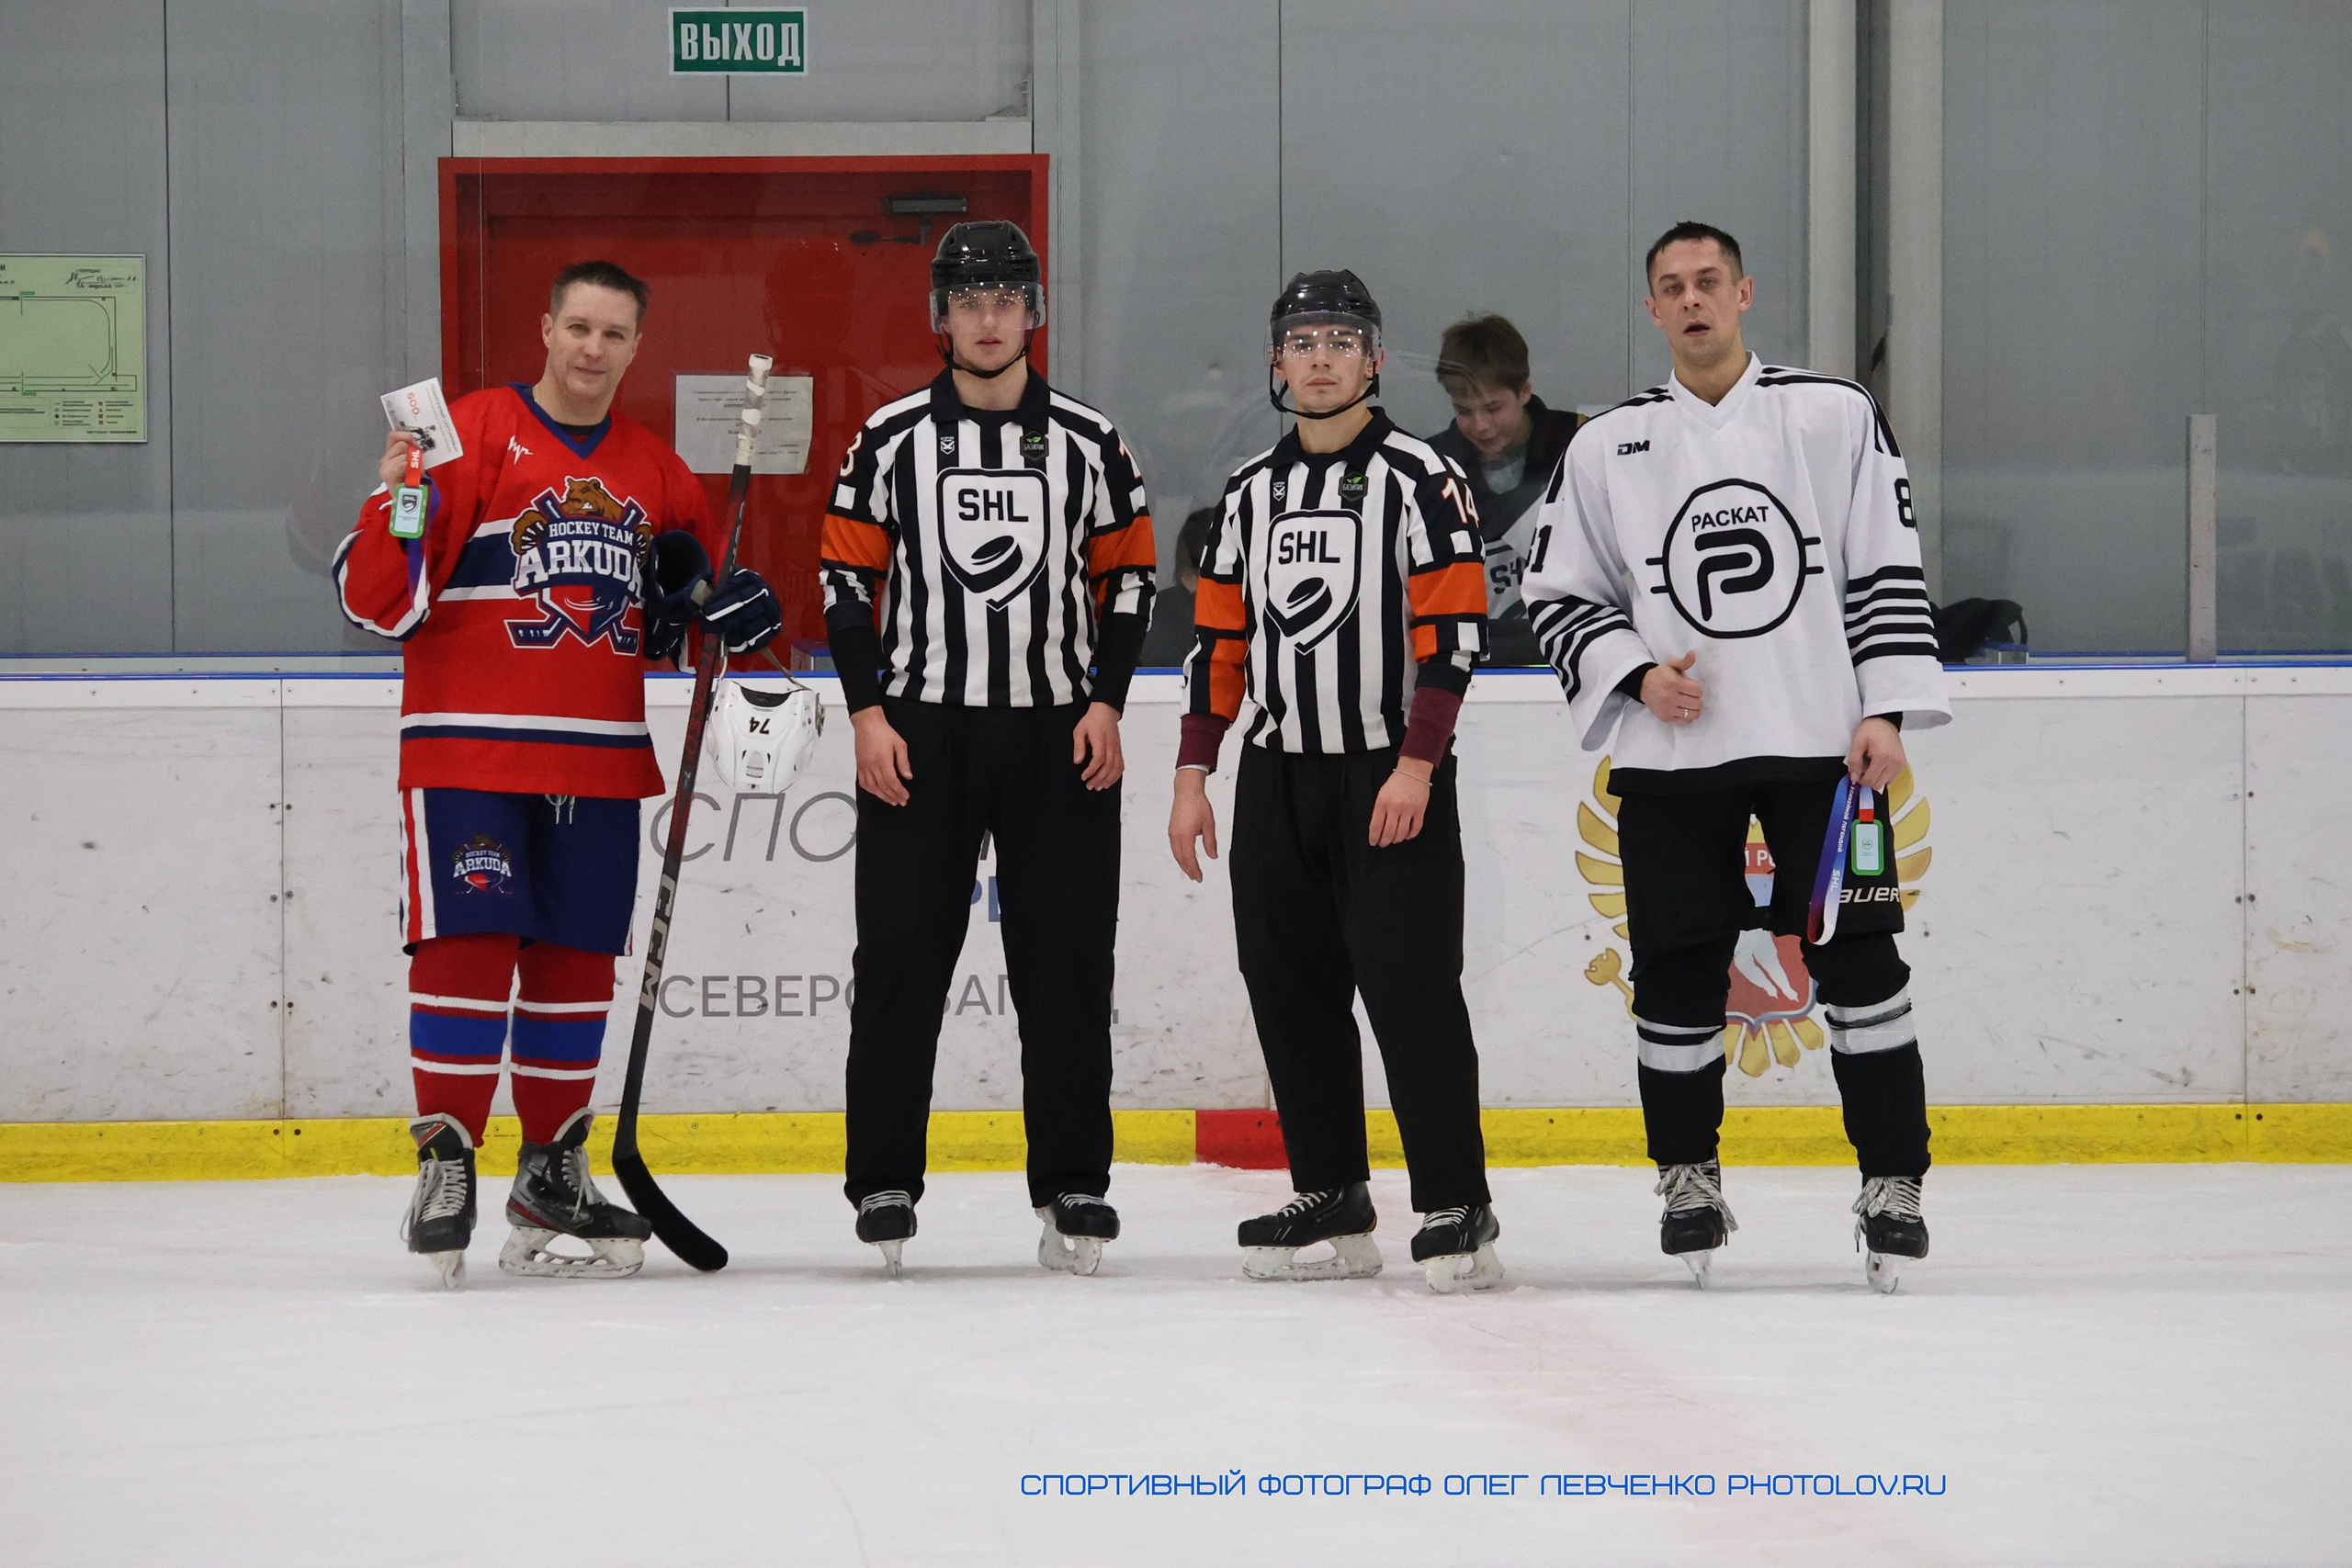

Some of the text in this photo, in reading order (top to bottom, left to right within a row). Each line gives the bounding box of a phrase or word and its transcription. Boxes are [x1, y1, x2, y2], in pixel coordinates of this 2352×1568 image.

[680, 22, 801, 67] ВЫХОД
[411, 449, 420, 469] SHL
[1617, 440, 1650, 456] DM
[957, 488, 1029, 523] SHL
[1442, 477, 1479, 528] 14
[1691, 506, 1770, 533] РАСКАТ
[548, 520, 636, 547] HOCKEY TEAM
[1278, 530, 1340, 565] SHL
[1525, 525, 1553, 573] 1
[514, 539, 642, 597] ARKUDA
[1490, 557, 1525, 595] SH
[749, 716, 770, 735] 74
[1843, 785, 1855, 820] ХОККЕЙНОЙ
[650, 791, 857, 862] СПО
[1838, 820, 1848, 853] ЛЕГЕНДОЙ
[453, 857, 512, 878] ARKUDA
[465, 850, 501, 859] HOCKEY TEAM
[1830, 868, 1841, 893] SHL
[1839, 886, 1901, 904] AUER
[639, 873, 677, 1012] CCM
